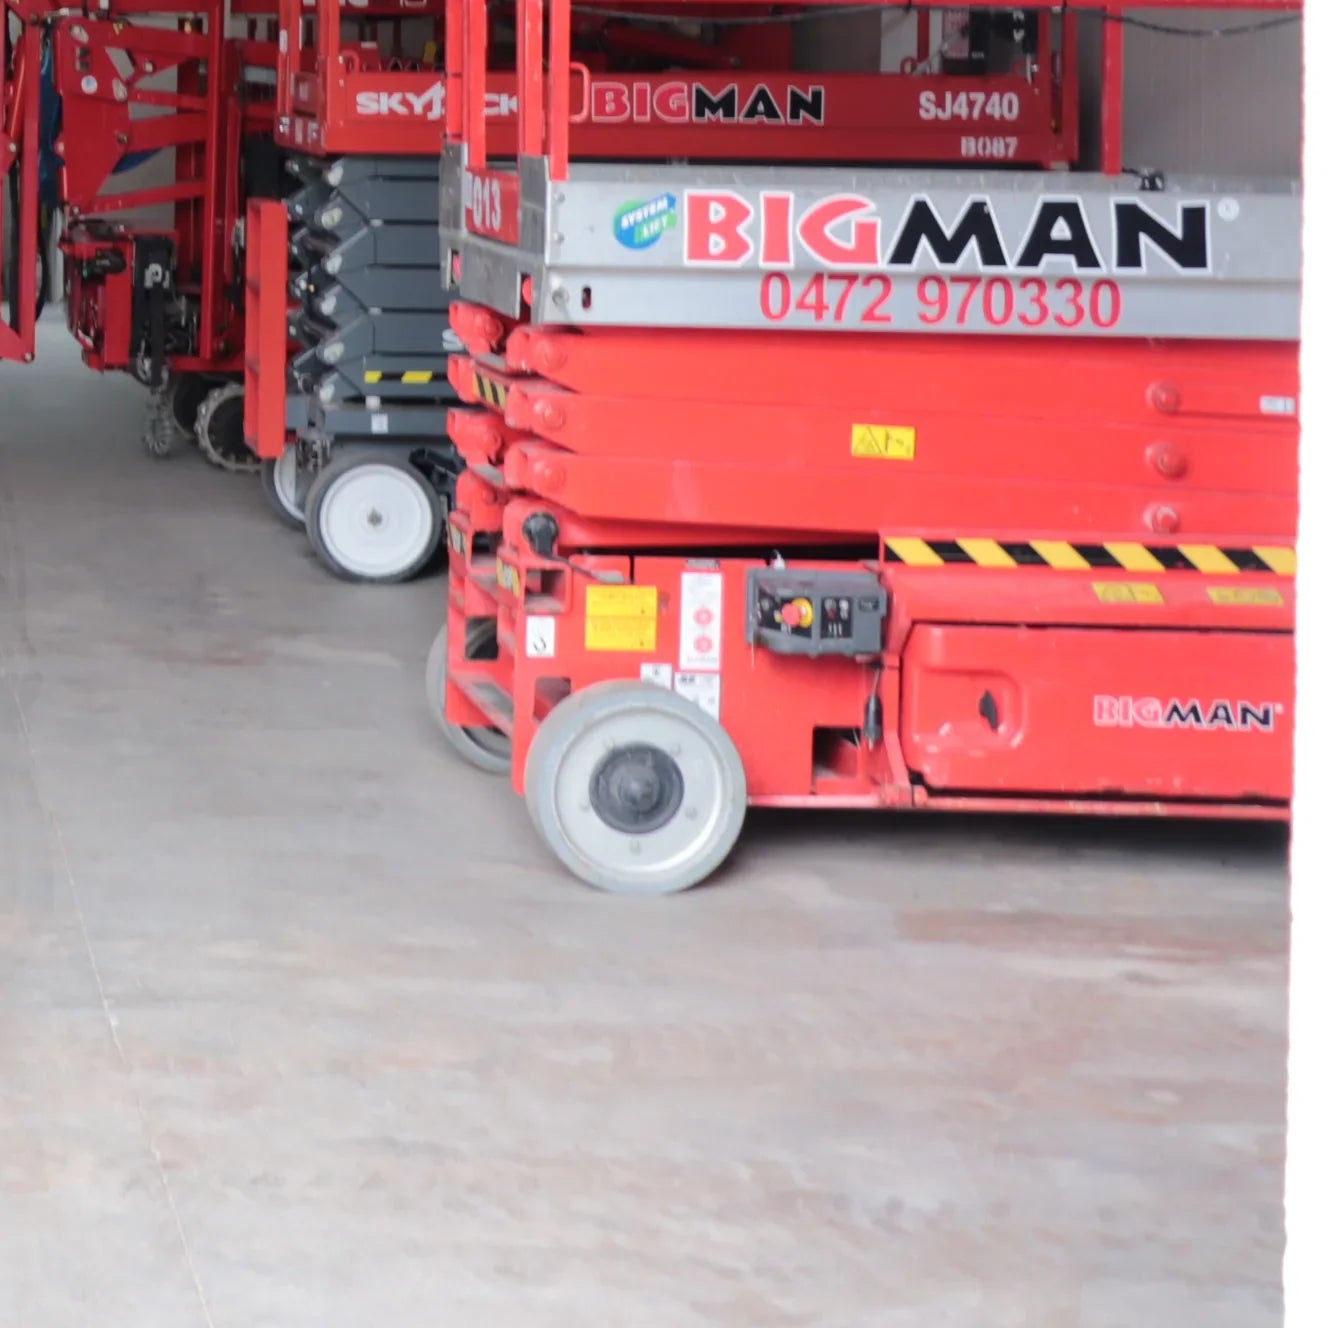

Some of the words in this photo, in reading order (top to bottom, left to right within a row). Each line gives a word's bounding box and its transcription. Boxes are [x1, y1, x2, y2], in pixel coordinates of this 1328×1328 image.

[356, 80, 519, 121] SKYJCK
[590, 81, 825, 126] BIGMAN
[919, 90, 1020, 121] SJ4740
[620, 196, 669, 229] SYSTEM
[642, 214, 669, 239] LIFT
[682, 189, 1212, 274] BIGMAN
[759, 272, 894, 324] 0472
[918, 276, 1123, 329] 970330
[1093, 694, 1275, 734] BIGMAN
